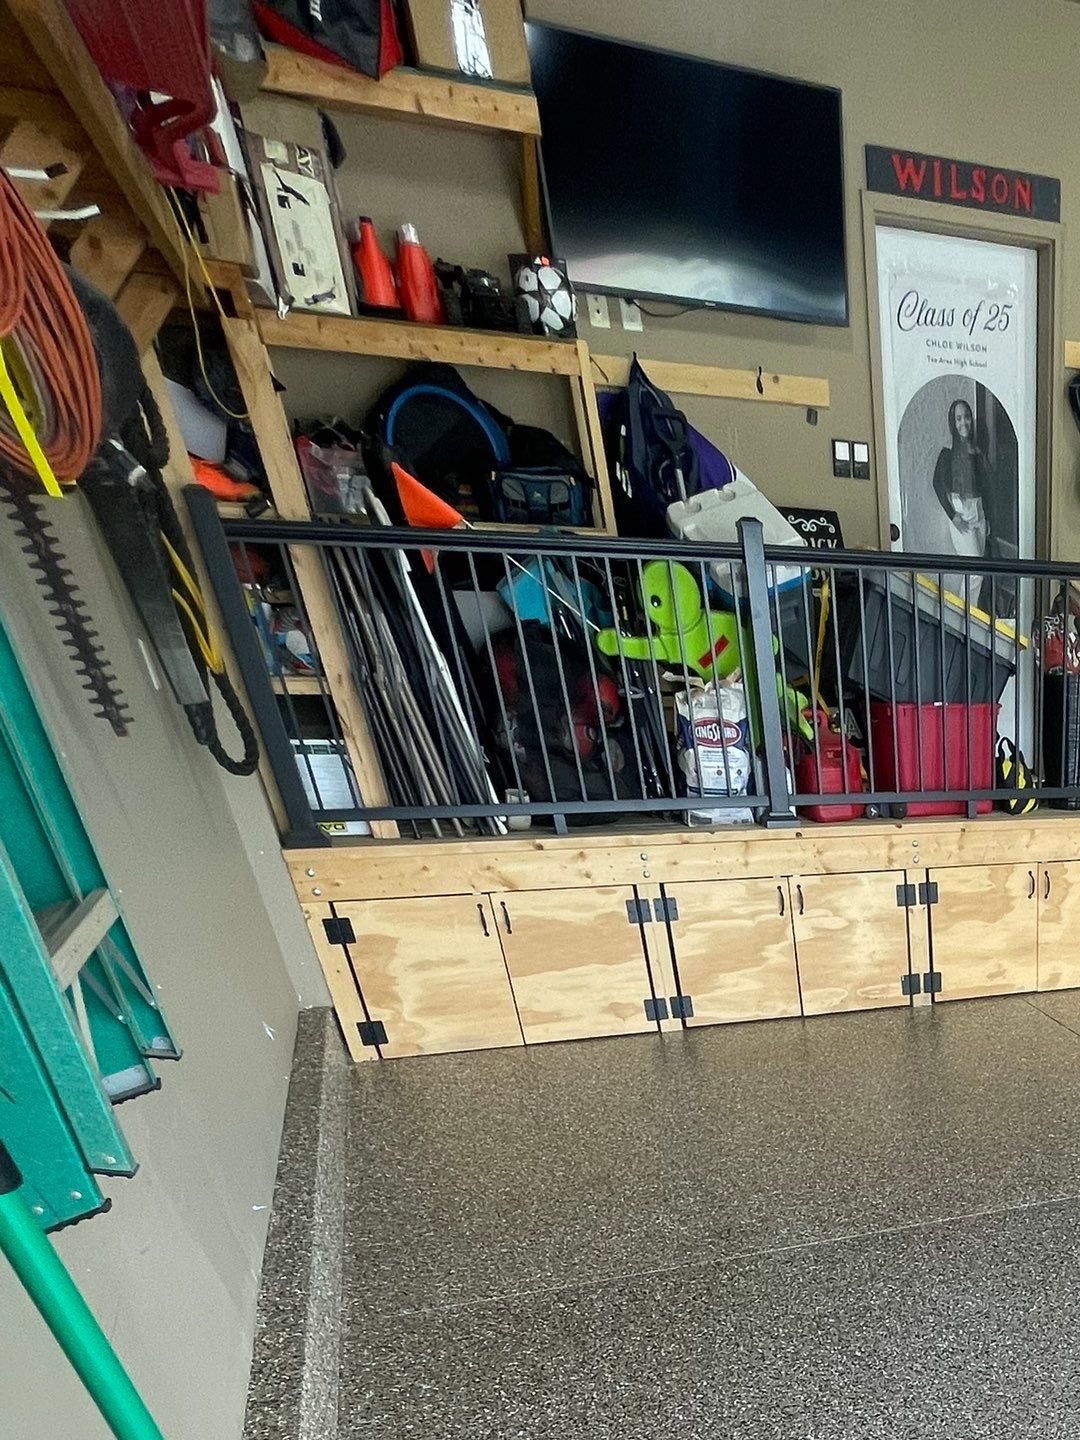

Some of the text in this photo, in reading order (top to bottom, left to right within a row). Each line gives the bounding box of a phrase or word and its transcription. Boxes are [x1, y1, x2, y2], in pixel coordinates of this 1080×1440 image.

[892, 154, 1033, 212] WILSON
[897, 290, 1013, 336] Class of 25
[925, 338, 988, 353] CHLOE WILSON
